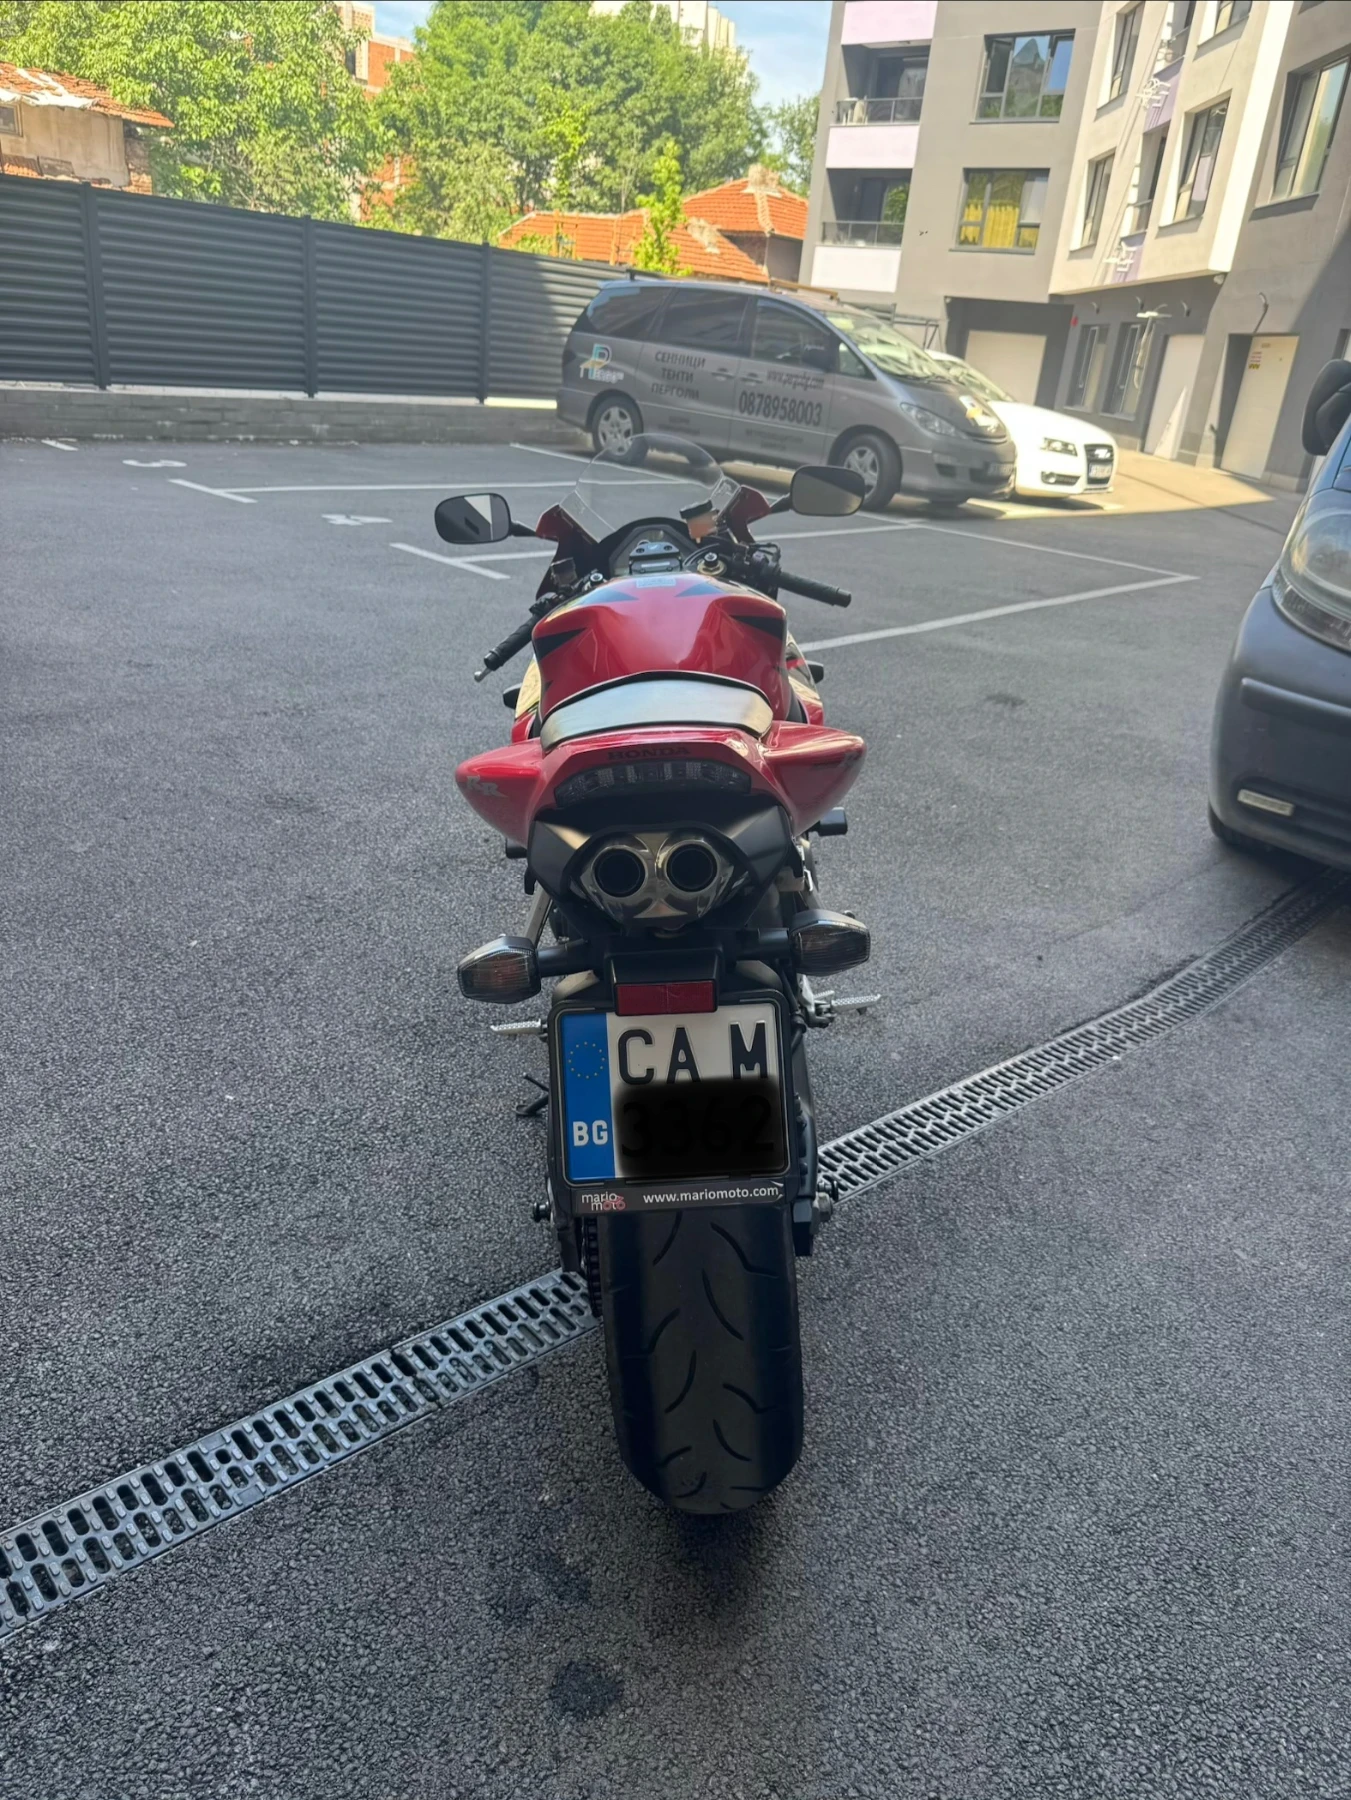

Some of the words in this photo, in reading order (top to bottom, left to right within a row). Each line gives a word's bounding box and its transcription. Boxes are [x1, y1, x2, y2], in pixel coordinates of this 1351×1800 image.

[655, 350, 706, 369] СЕННИЦИ
[661, 368, 694, 383] ТЕНТИ
[651, 383, 700, 399] ПЕРГОЛИ
[738, 391, 823, 427] 0878958003
[608, 747, 690, 760] HONDA
[467, 775, 508, 797] RR
[572, 1119, 608, 1147] BG
[581, 1191, 618, 1204] mario
[643, 1186, 779, 1203] www.mariomoto.com
[591, 1199, 626, 1211] moto
